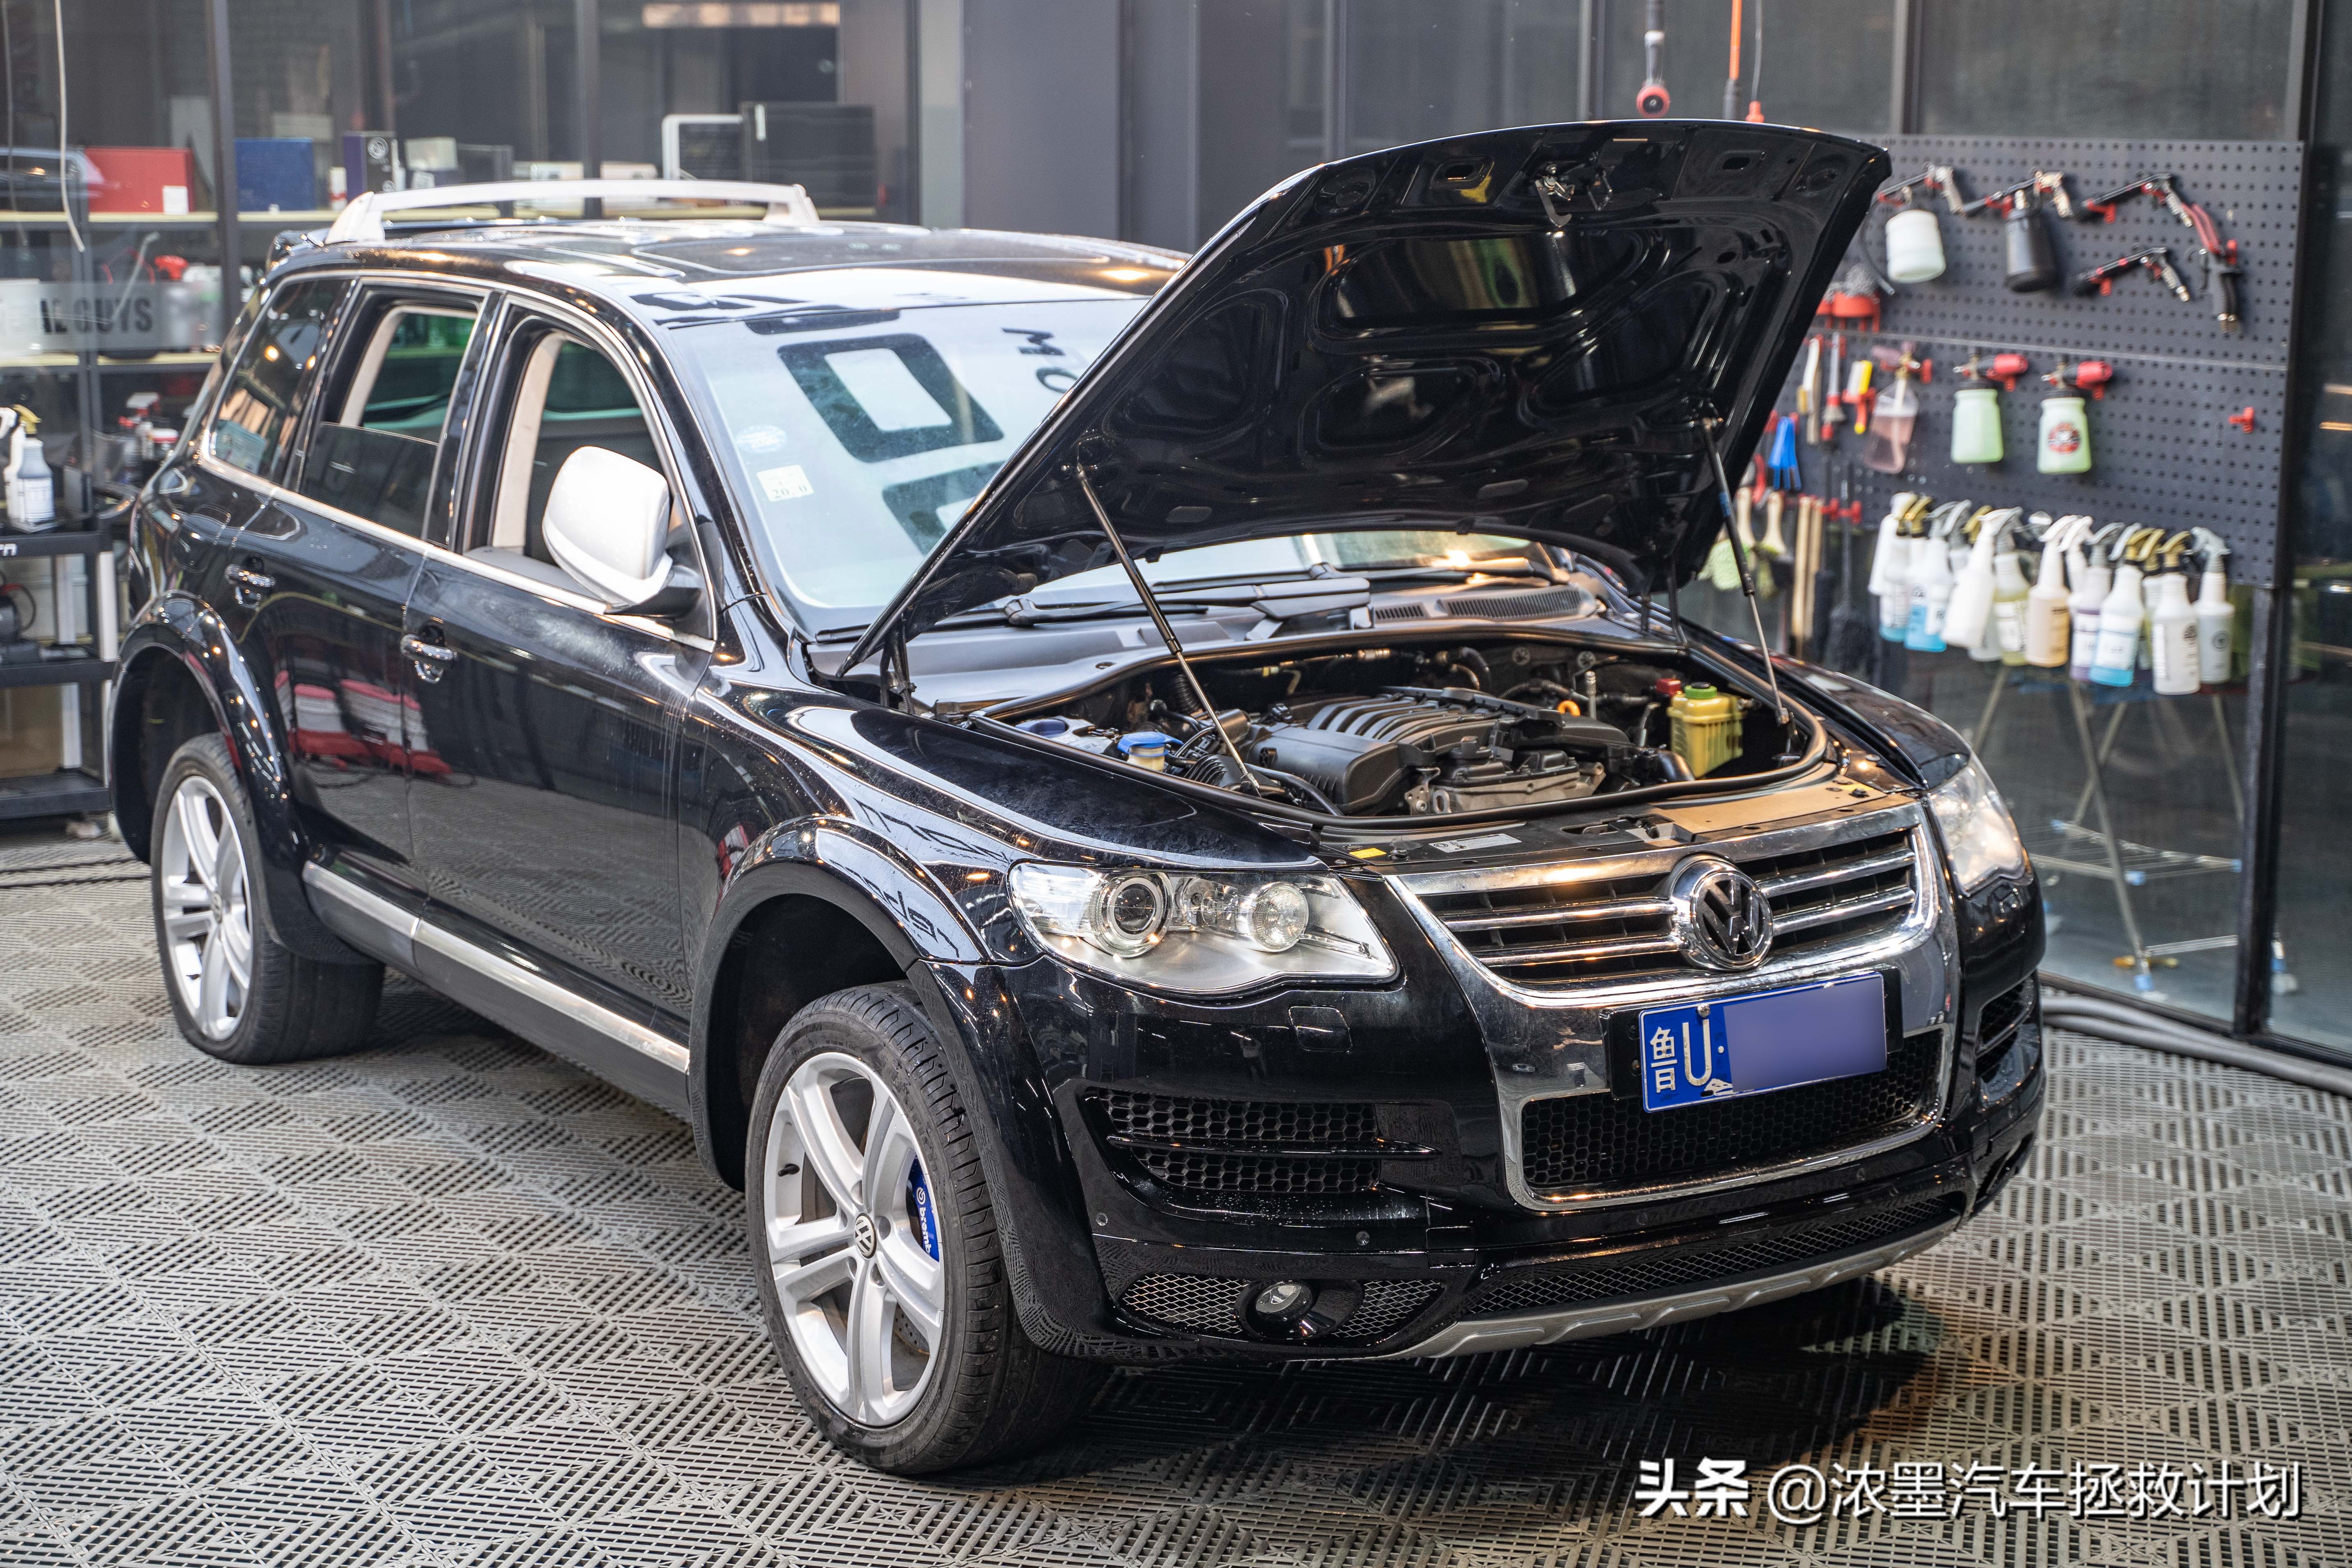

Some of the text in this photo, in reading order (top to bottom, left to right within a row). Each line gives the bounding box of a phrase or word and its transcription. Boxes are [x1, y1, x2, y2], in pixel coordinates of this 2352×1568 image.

[73, 295, 154, 335] GUYS
[770, 483, 807, 499] 200
[919, 1207, 932, 1257] bremb
